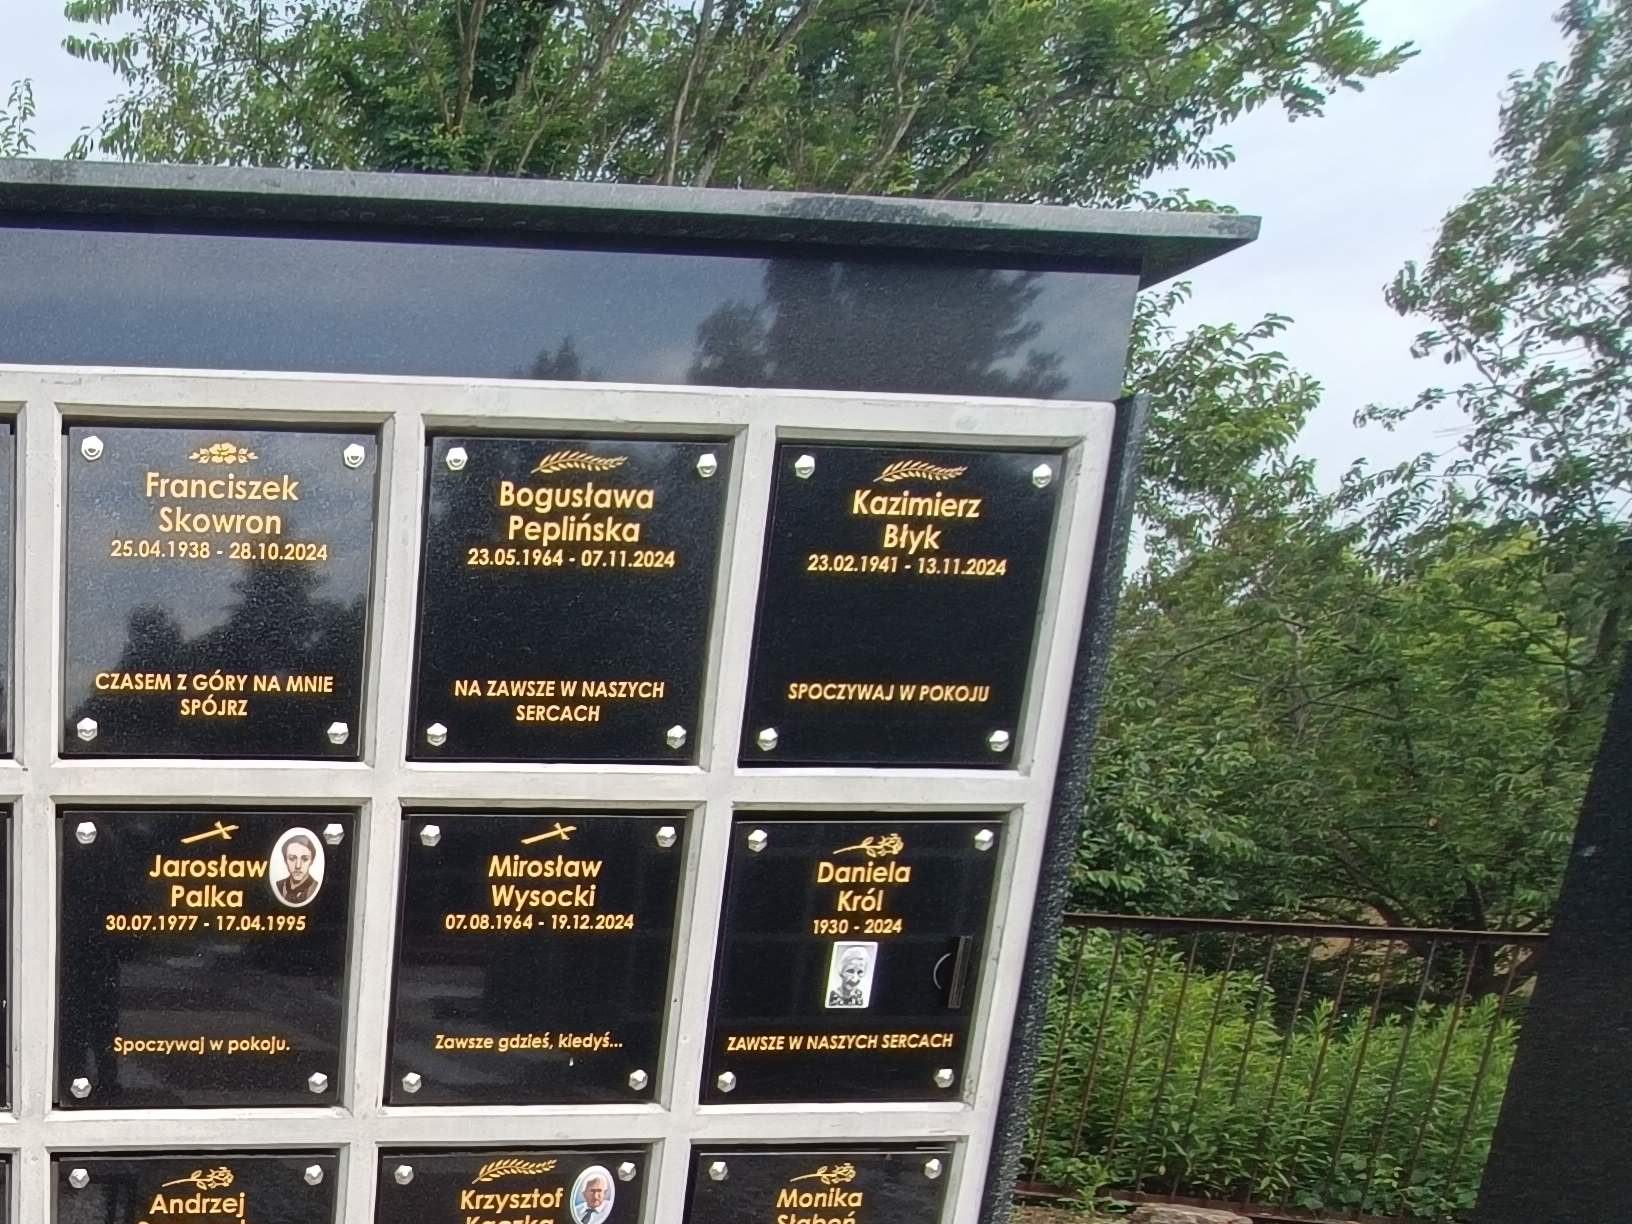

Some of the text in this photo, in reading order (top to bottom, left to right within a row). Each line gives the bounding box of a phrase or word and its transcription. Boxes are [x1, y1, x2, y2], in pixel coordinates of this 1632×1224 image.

[145, 470, 300, 502] Franciszek
[498, 479, 656, 515] Bogusława
[851, 488, 983, 519] Kazimierz
[157, 505, 282, 536] Skowron
[507, 511, 642, 548] Peplińska
[110, 539, 328, 561] 25.04.1938 28.10.2024
[882, 522, 943, 556] Błyk
[467, 547, 676, 568] 23.05.1964 07.11.2024
[807, 553, 1007, 576] 23.02.1941 13.11.2024
[95, 667, 334, 693] CZASEM Z GÓRY NA MNIE
[454, 679, 665, 699] NA ZAWSZE NASZYCH
[787, 682, 990, 702] SPOCZYWAJ POKOJU
[179, 692, 250, 717] SPÓJRZ
[515, 704, 601, 722] SERCACH
[148, 852, 269, 880] Jarosław
[487, 853, 604, 879] Mirosław
[815, 859, 913, 885] Daniela
[170, 883, 245, 909] Palka
[490, 883, 598, 913] Wysocki
[836, 886, 885, 913] Król
[105, 914, 307, 931] 30.07.1977 17.04.1995
[445, 913, 634, 930] 07.08.1964 19.12.2024
[813, 918, 903, 935] 1930 2024
[113, 1035, 291, 1056] Spoczywaj pokoju.
[434, 1030, 624, 1054] Zawsze gdzieś, kiedyś...
[726, 1033, 954, 1051] ZAWSZE NASZYCH SERCACH
[147, 1190, 247, 1219] Andrzej
[459, 1186, 565, 1215] Krzysztof
[775, 1186, 865, 1209] Monika
